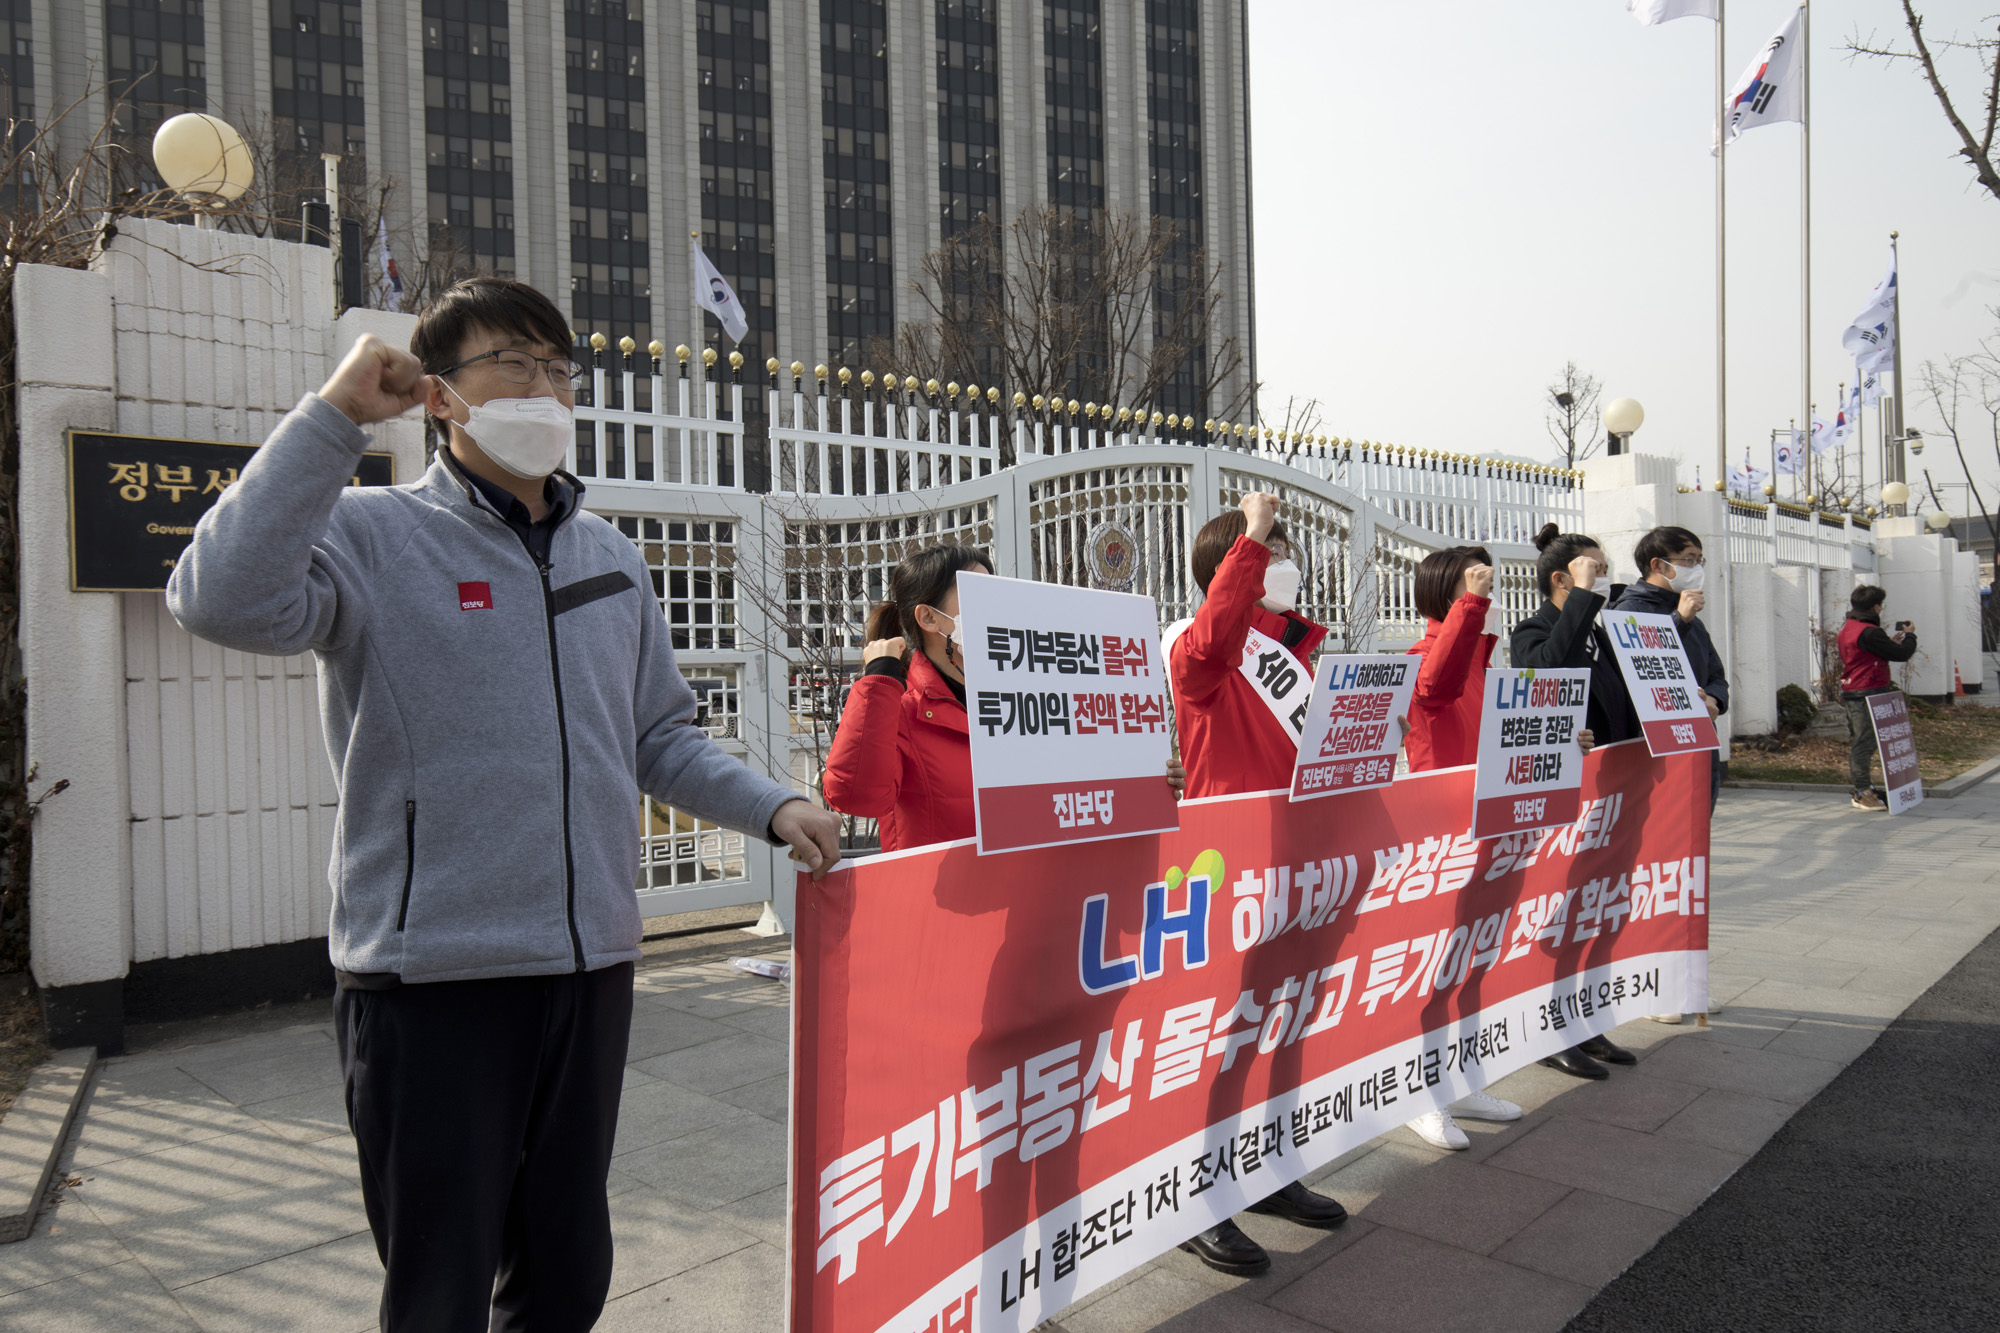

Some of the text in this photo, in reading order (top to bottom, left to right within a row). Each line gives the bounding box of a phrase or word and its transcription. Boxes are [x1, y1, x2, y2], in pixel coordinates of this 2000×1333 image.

[986, 626, 1150, 677] 투기부동산 몰수!
[1631, 655, 1686, 680] 변창흠 장관
[977, 691, 1167, 737] 투기이익 전액 환수!
[1329, 692, 1394, 725] 주택청을
[1651, 686, 1692, 712] 사퇴하라
[1318, 723, 1390, 757] 신설하라!
[1500, 714, 1574, 748] 변창흠 장관
[1670, 724, 1697, 744] 진보당
[1301, 765, 1336, 790] 진보당
[1352, 758, 1391, 785] 송명숙
[1332, 775, 1344, 785] 후보
[1505, 752, 1562, 785] 사퇴하라
[1053, 789, 1115, 829] 진보당
[1513, 797, 1547, 823] 진보당
[1080, 874, 1211, 995] LH
[1231, 854, 1358, 952] 해체!
[1547, 793, 1623, 858] 사퇴!
[817, 855, 1707, 1286] 투기부동산 몰수하고 투기이익 전액 환수하라!
[1001, 1249, 1041, 1313] LH
[1051, 1190, 1136, 1282] 합조단
[1145, 1166, 1180, 1221] 1차
[1189, 1117, 1284, 1198] 조사결과
[1290, 1083, 1354, 1147] 발표에
[1359, 1065, 1399, 1112] 따른
[1404, 1048, 1441, 1092] 긴급
[1446, 1017, 1510, 1073] 기자회견
[1539, 1003, 1567, 1032] 3월
[1565, 986, 1594, 1020] 11일
[1597, 976, 1627, 1010] 오후
[1630, 968, 1660, 998] 3시
